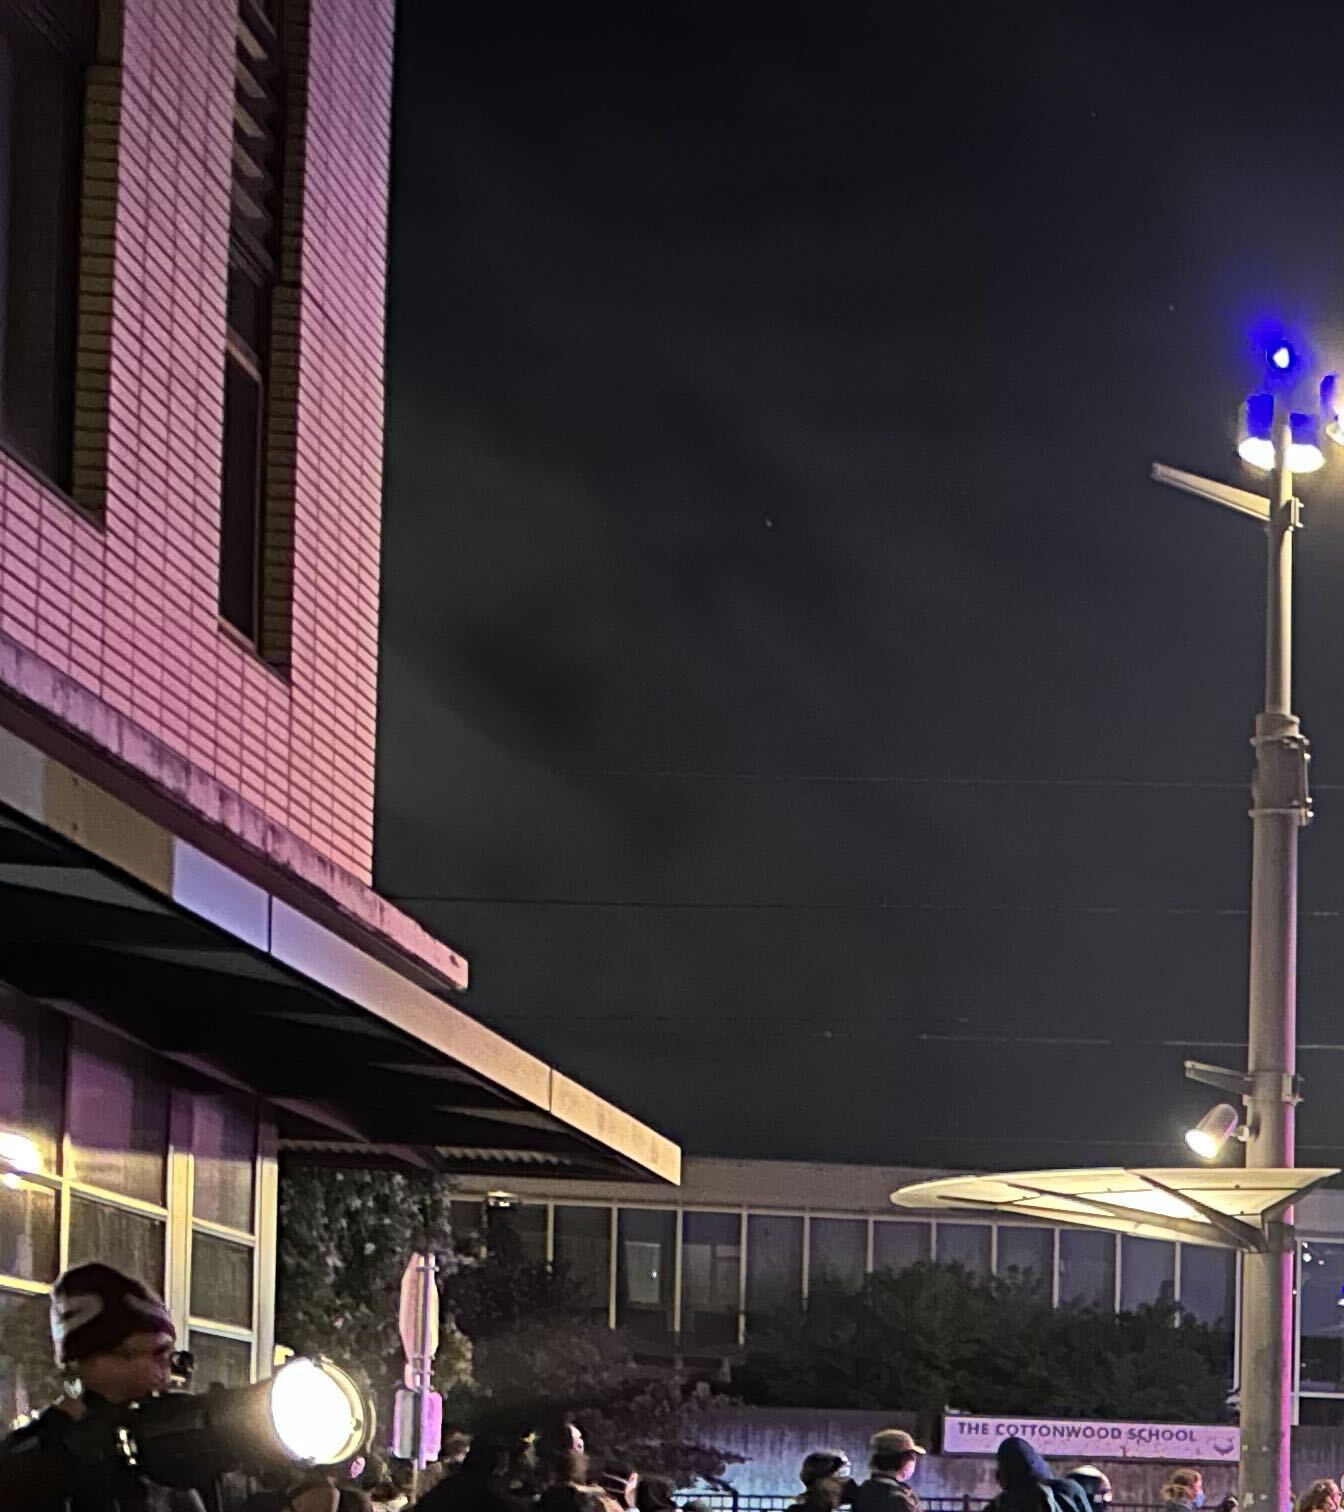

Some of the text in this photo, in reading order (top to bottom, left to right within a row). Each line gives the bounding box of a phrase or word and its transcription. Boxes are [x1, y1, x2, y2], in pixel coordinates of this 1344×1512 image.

[958, 1421, 1197, 1442] THE COTTONWOOD SCHOOL
